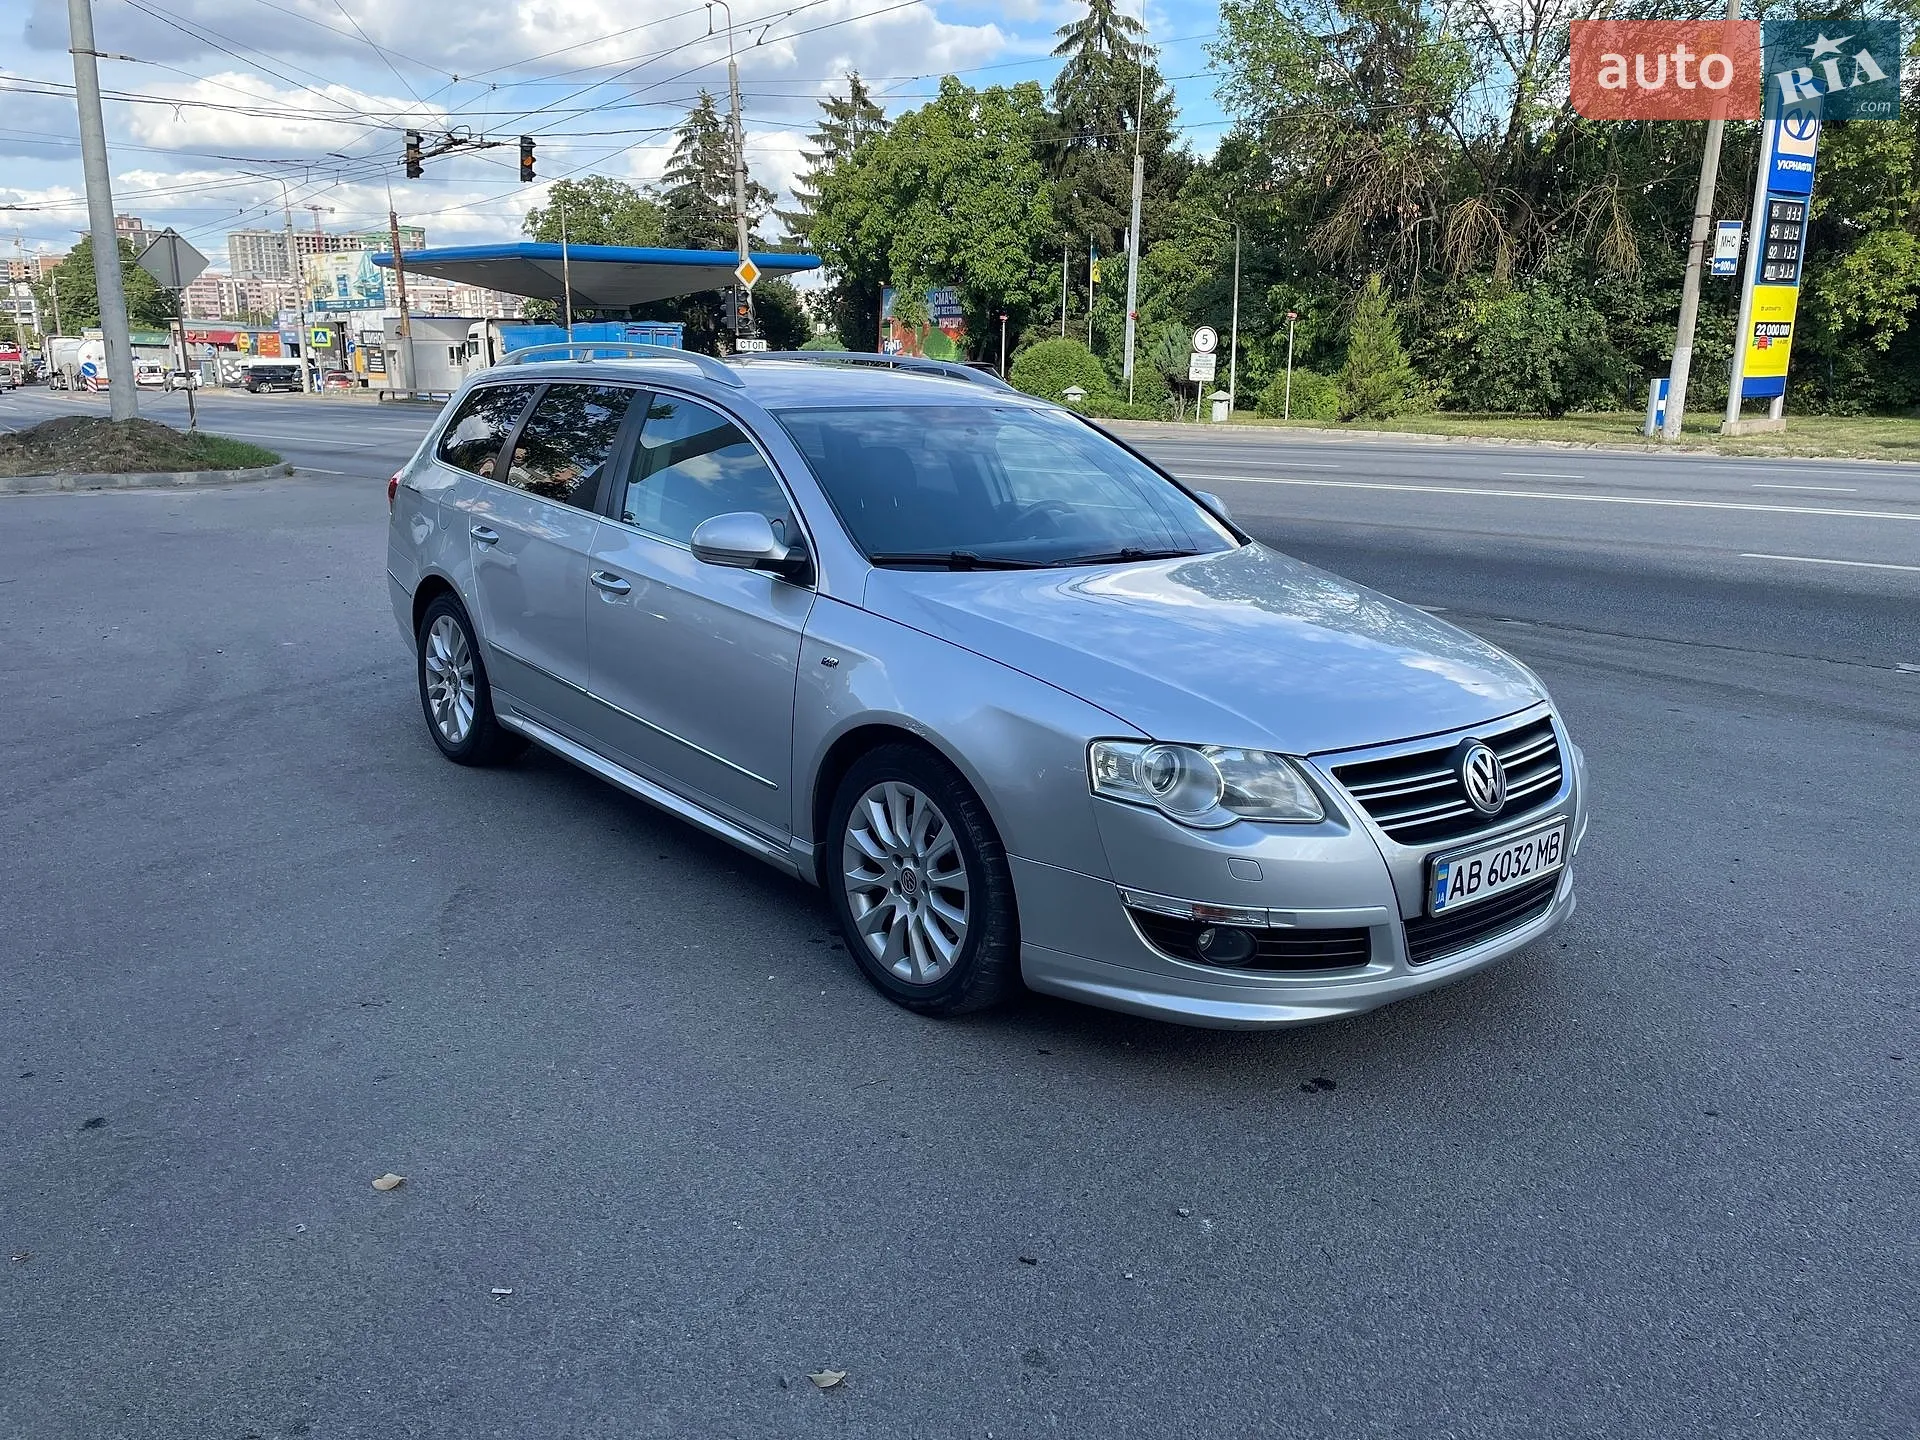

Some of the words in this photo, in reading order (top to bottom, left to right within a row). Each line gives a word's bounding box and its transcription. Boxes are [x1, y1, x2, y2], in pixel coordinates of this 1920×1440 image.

[1777, 159, 1812, 173] УКРНАФТА
[1767, 245, 1778, 259] 92
[1755, 324, 1767, 336] 22
[740, 340, 764, 350] СТОП
[1201, 334, 1209, 345] 5
[1448, 859, 1483, 901] AB
[1487, 842, 1534, 887] 6032
[1535, 831, 1561, 871] MB
